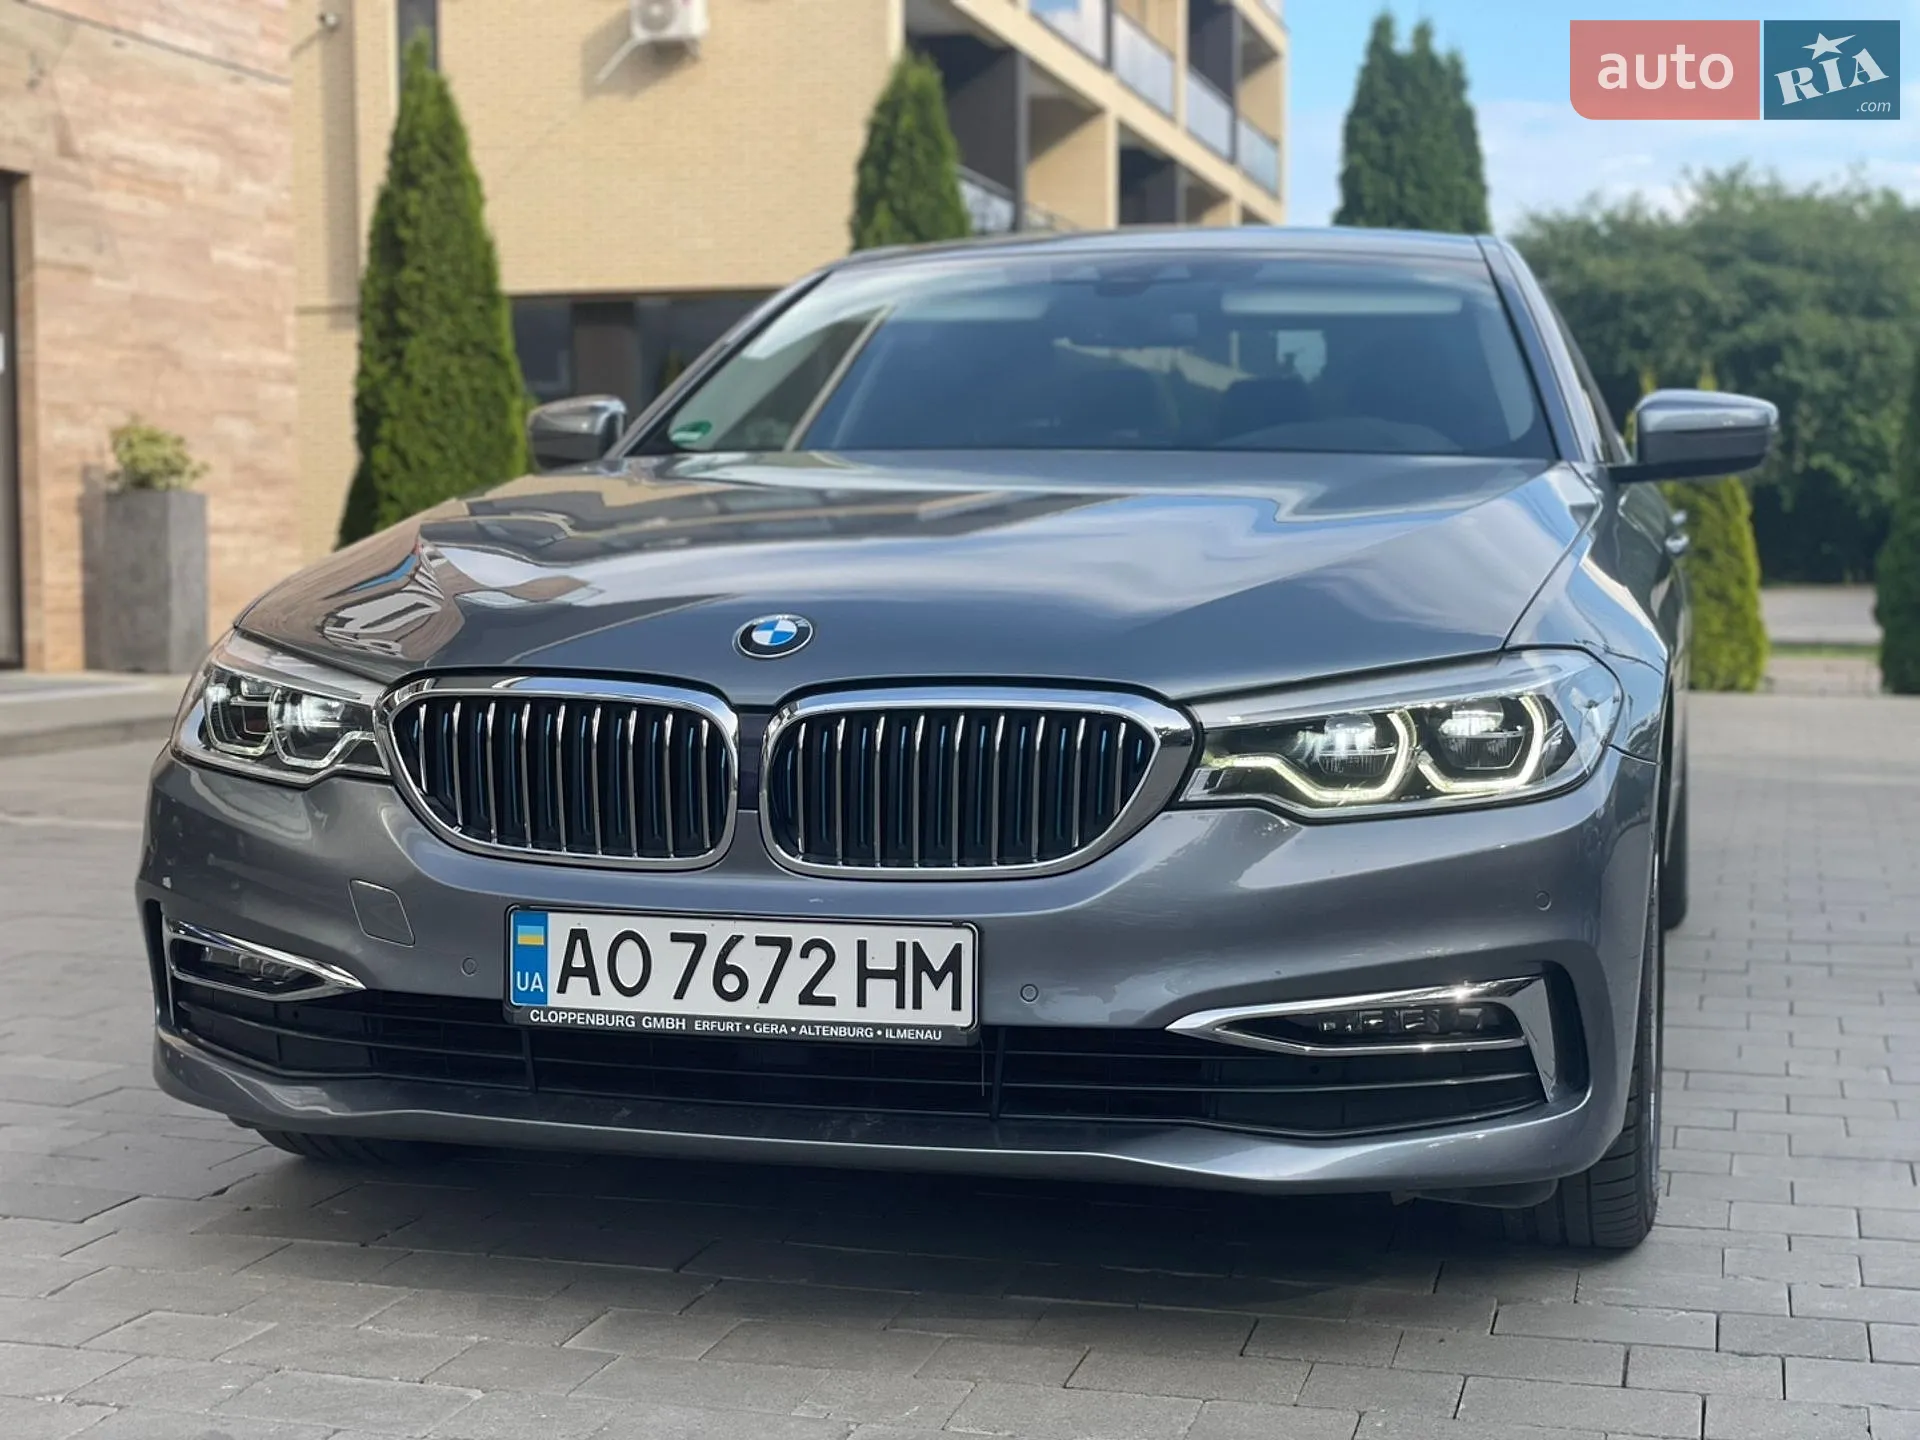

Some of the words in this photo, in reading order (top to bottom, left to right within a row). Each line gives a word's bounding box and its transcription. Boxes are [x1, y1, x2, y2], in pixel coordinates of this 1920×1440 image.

[516, 971, 544, 993] UA
[556, 927, 653, 998] AO
[669, 931, 838, 1007] 7672
[856, 938, 963, 1012] HM
[530, 1009, 636, 1028] CLOPPENBURG
[642, 1016, 686, 1031] GMBH
[694, 1020, 741, 1033] ERFURT
[753, 1023, 788, 1035] GERA
[799, 1025, 874, 1039] ALTENBURG
[885, 1028, 943, 1041] ILMENAU
